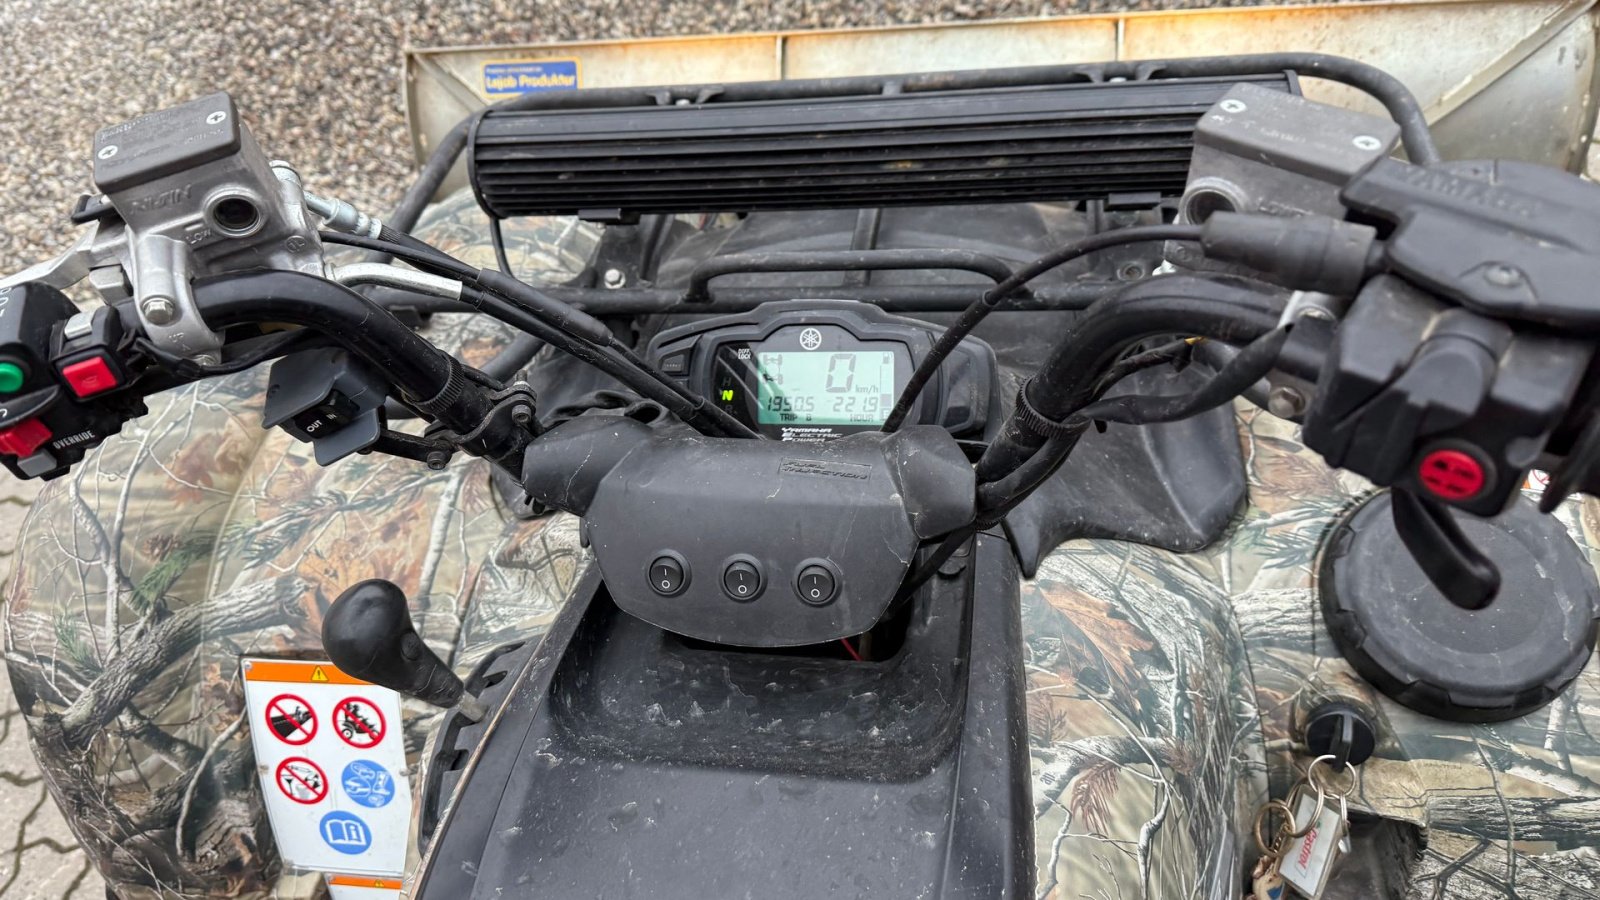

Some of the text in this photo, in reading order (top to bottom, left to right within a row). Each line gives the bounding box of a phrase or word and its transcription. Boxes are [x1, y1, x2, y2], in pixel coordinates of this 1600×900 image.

[825, 353, 856, 393] 0
[855, 385, 879, 394] km/h
[722, 390, 733, 401] N
[780, 413, 798, 422] TRIP
[850, 413, 874, 422] HOUR
[306, 419, 322, 432] OUT
[52, 429, 96, 450] OVERRIDE
[783, 460, 826, 470] FUEL
[781, 466, 868, 480] INJECTION
